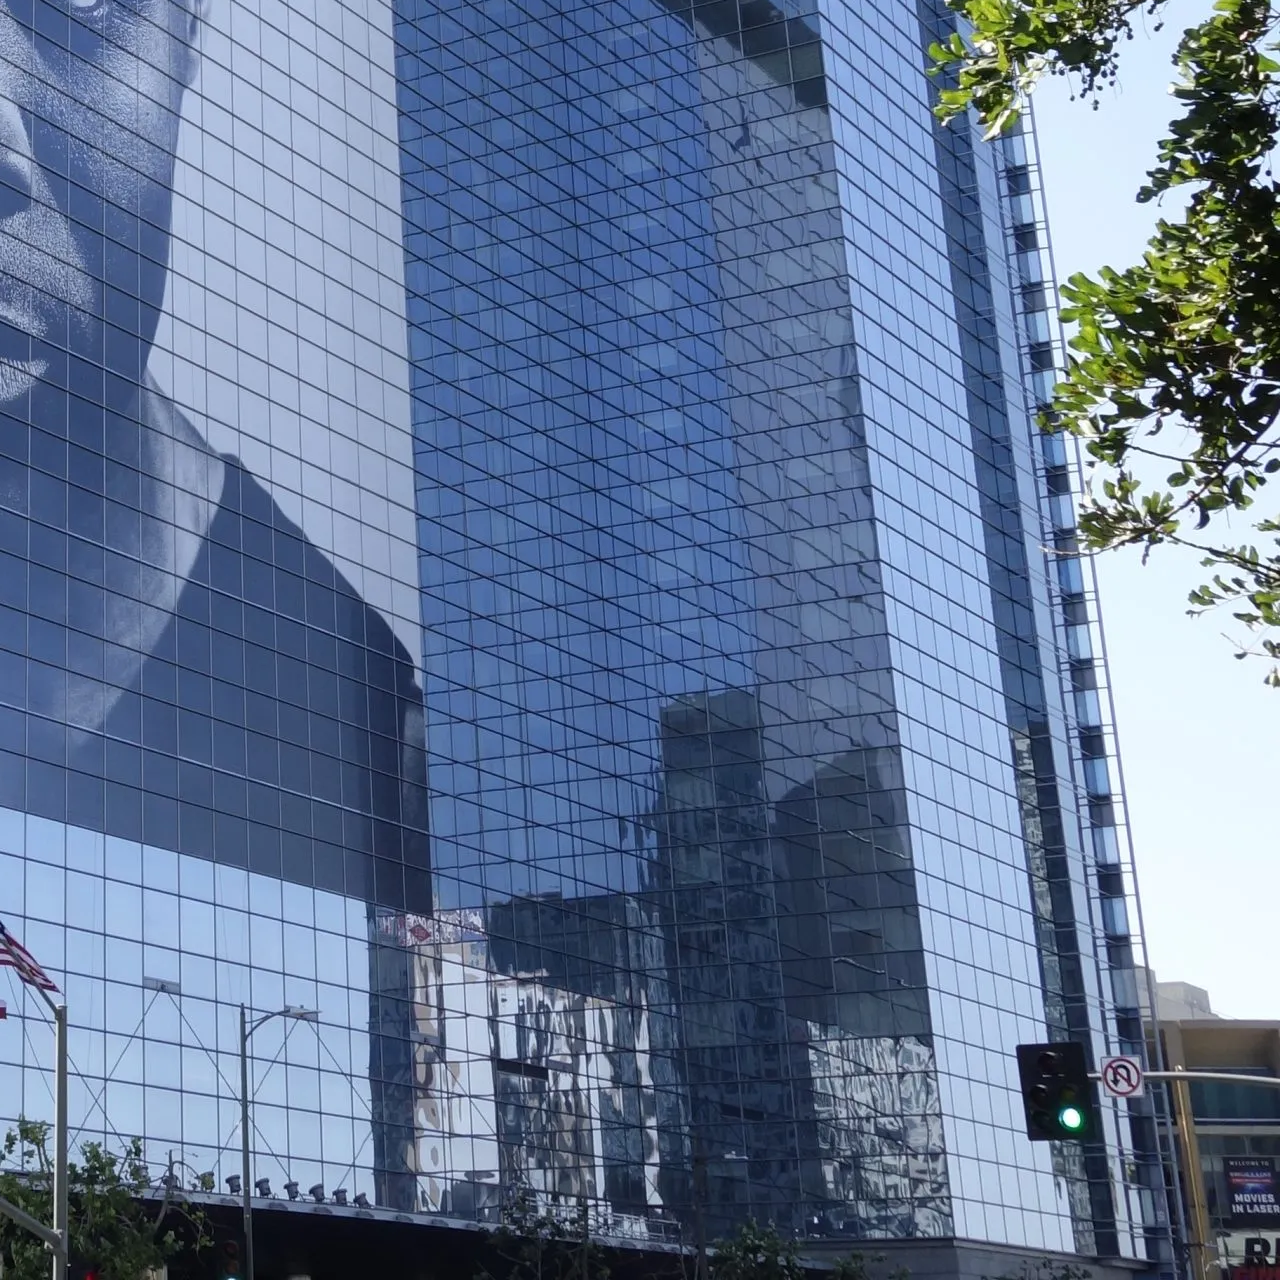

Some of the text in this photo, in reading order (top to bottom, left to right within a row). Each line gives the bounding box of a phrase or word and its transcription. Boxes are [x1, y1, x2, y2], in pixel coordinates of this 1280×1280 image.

[1234, 1193, 1275, 1203] MOVIES
[1231, 1204, 1280, 1214] IN LASER
